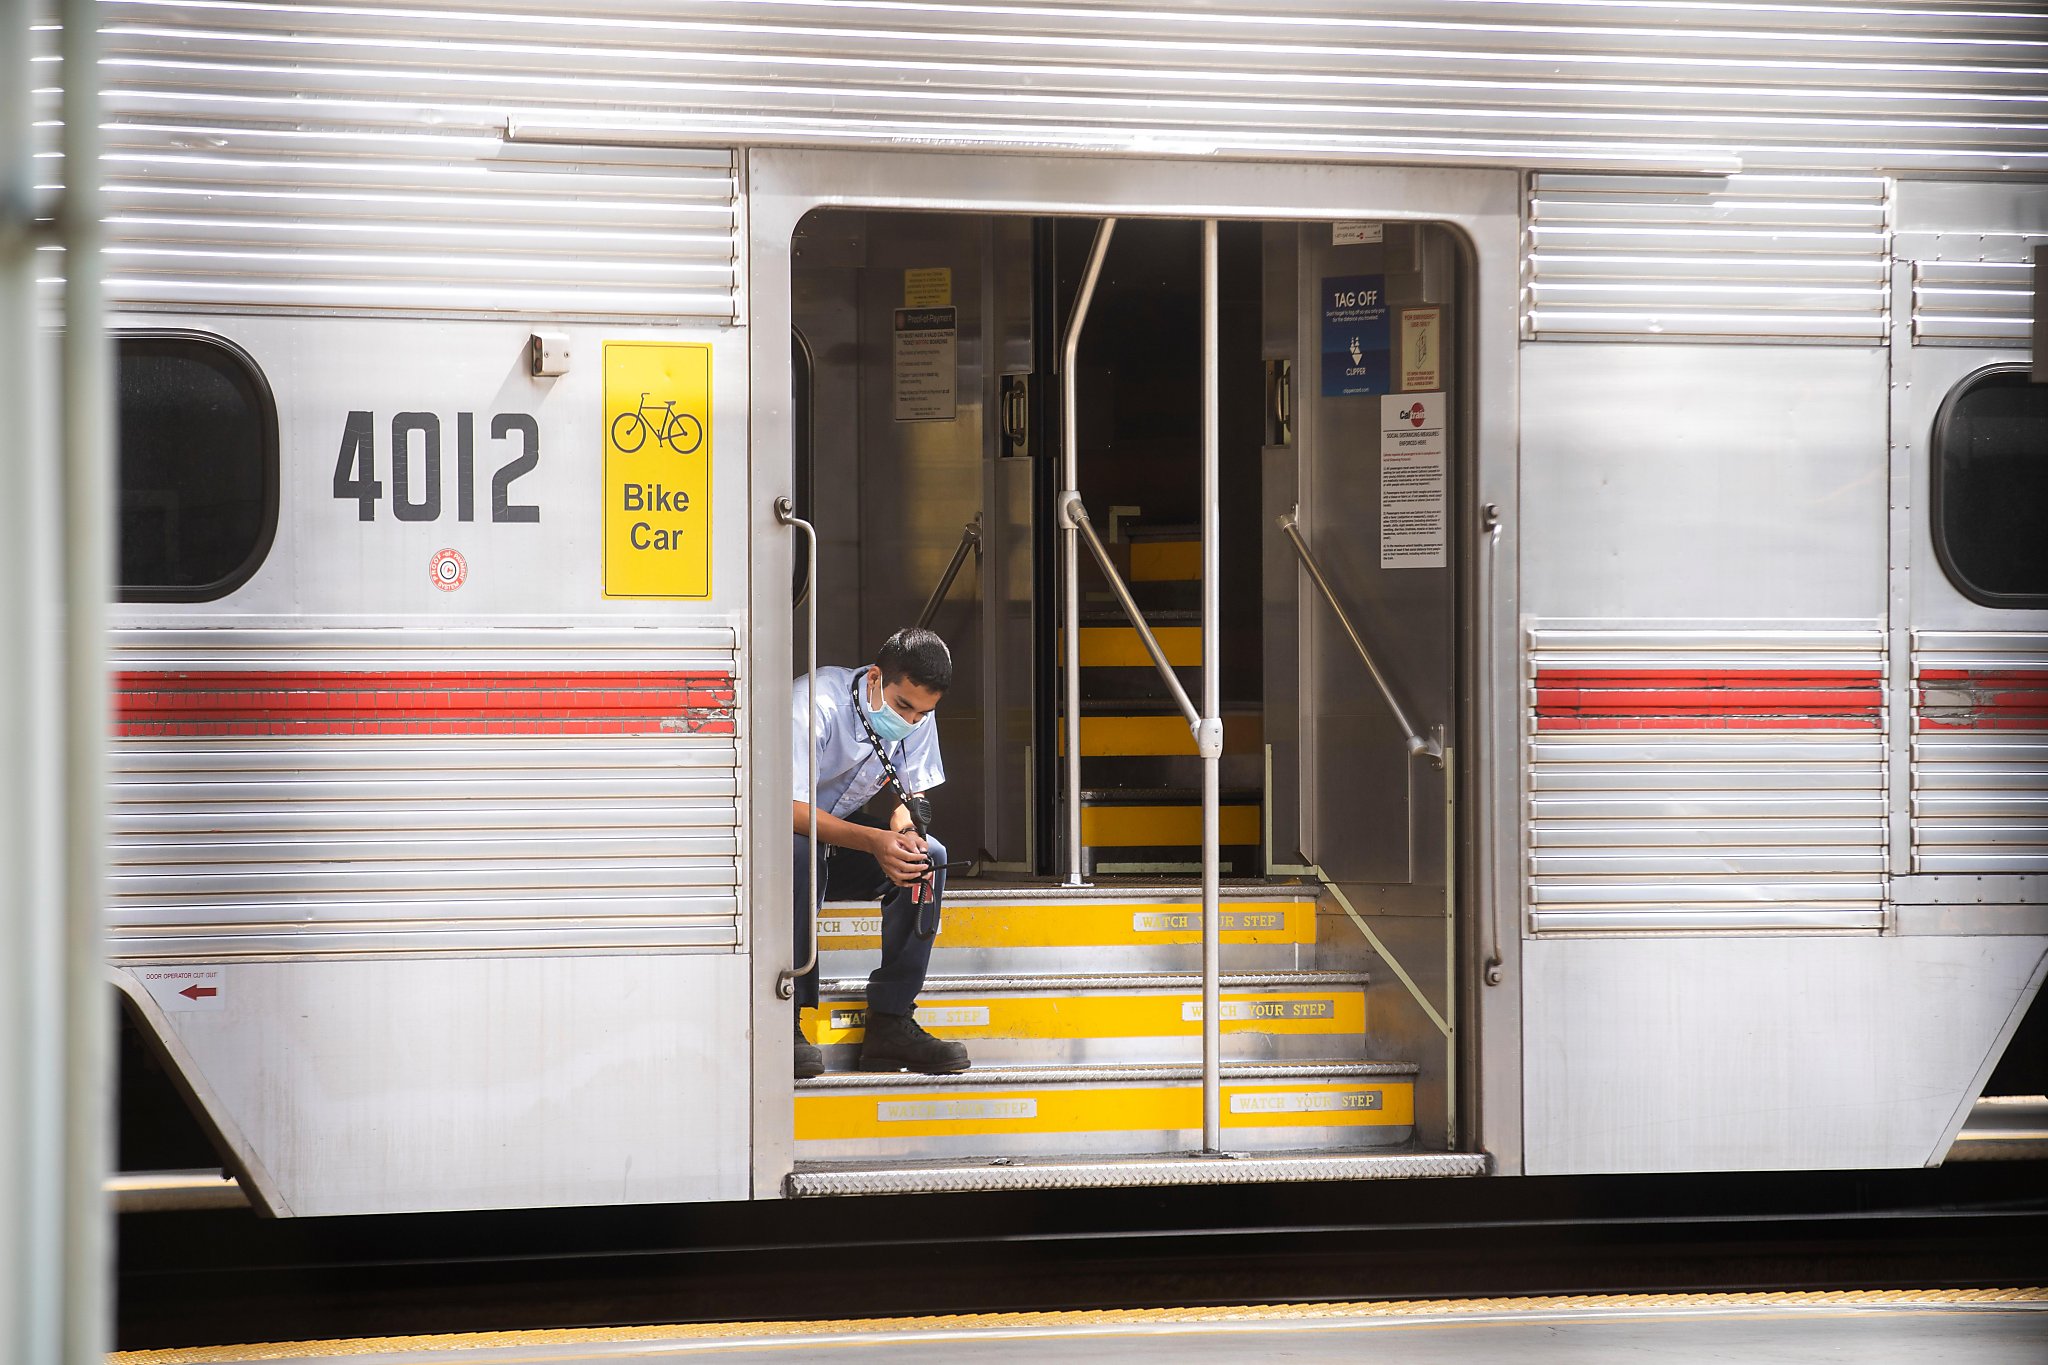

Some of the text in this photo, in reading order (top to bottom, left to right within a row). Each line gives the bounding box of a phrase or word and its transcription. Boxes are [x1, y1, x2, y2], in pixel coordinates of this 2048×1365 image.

[1335, 291, 1377, 307] TAG OFF
[1346, 368, 1366, 376] CLIPPER
[333, 411, 540, 523] 4012
[624, 483, 689, 512] Bike
[630, 522, 684, 550] Car
[816, 920, 882, 932] TCH YOU
[1142, 916, 1276, 928] WATCH YUR STEP
[840, 1012, 866, 1025] WAT
[946, 1010, 981, 1022] STEP
[1192, 1004, 1326, 1017] WCH YOUR STEP
[888, 1102, 1029, 1117] WATCH YOUR STEP
[1240, 1095, 1374, 1109] WATCH YOUR STEP
